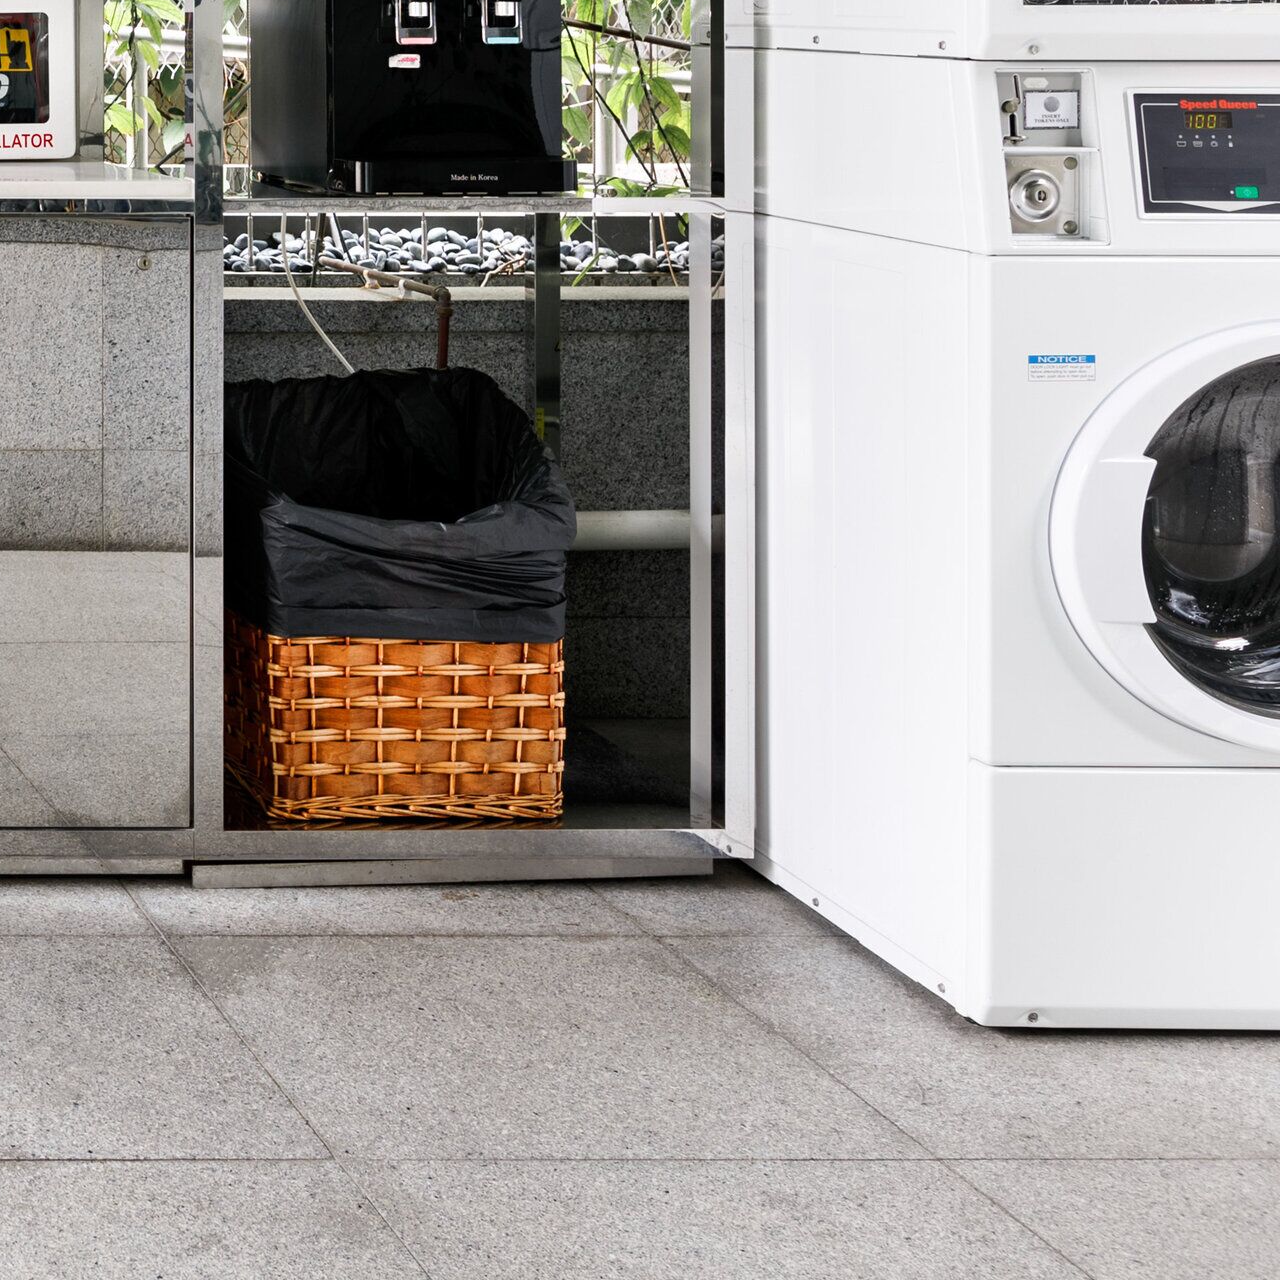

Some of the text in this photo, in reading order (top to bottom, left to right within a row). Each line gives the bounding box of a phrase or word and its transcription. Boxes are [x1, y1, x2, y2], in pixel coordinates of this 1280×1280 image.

[1179, 99, 1257, 111] Speed Queen
[1189, 114, 1217, 129] 100
